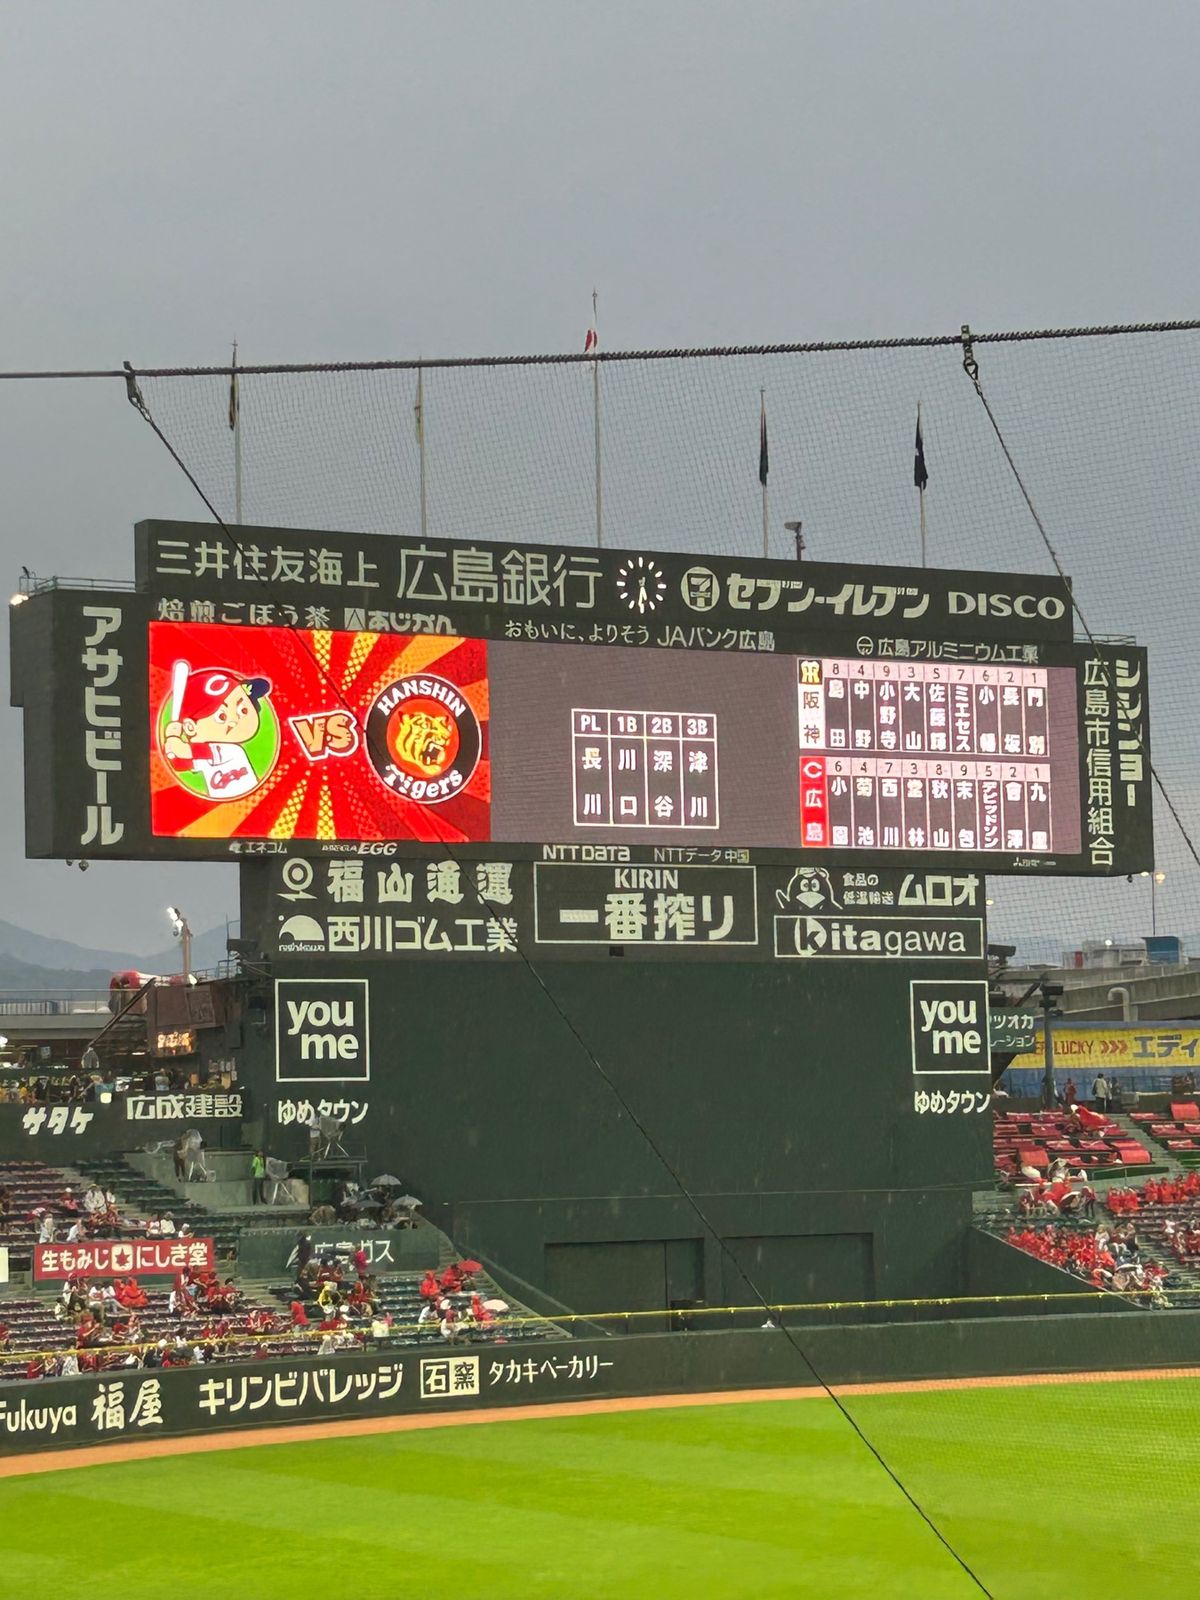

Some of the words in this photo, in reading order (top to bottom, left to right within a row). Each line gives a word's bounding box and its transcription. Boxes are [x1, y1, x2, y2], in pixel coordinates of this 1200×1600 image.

[155, 540, 380, 588] 三井住友海上
[397, 544, 603, 608] 広島銀行
[368, 609, 457, 635] あじかん
[948, 591, 1065, 619] DISCO
[504, 619, 649, 643] おもいに、よりそう
[657, 625, 776, 651] JAバンク広島
[878, 637, 1039, 664] 広島アルミニウム工業
[831, 663, 840, 675] 8
[857, 664, 865, 676] 4
[882, 665, 891, 677] 9
[907, 666, 916, 678] 3
[933, 668, 941, 679] 5
[957, 669, 965, 680] 7
[982, 670, 990, 682] 6
[1007, 671, 1015, 683] 2
[1031, 672, 1037, 684] 1
[377, 679, 466, 717] HANSHIN
[854, 680, 872, 749] 中野
[879, 681, 897, 750] 小野寺
[80, 605, 125, 846] アサヒビール
[580, 714, 601, 732] PL
[617, 715, 638, 733] 1B
[651, 717, 673, 734] 2B
[687, 718, 708, 735] 3B
[803, 691, 820, 744] 阪神
[904, 682, 922, 750] 大山
[954, 685, 971, 752] ミエセス
[291, 712, 356, 759] VS
[834, 760, 842, 773] 6
[860, 761, 868, 774] 4
[884, 762, 893, 774] 7
[910, 763, 918, 775] 3
[935, 763, 943, 776] 8
[960, 764, 968, 776] 9
[985, 765, 993, 777] 5
[1009, 766, 1017, 778] 2
[1034, 767, 1040, 779] 1
[1083, 657, 1115, 866] 広島市信用組合
[383, 763, 463, 799] Tigers
[582, 747, 602, 816] 長川
[618, 749, 638, 816] 川口
[653, 750, 674, 818] 深谷
[688, 750, 709, 818] 津川
[805, 788, 823, 841] 広島
[881, 778, 899, 847] 西川
[931, 779, 950, 847] 秋山
[244, 842, 287, 854] エネコム
[358, 842, 398, 856] EGG
[327, 860, 514, 904] 福山通運
[614, 868, 679, 889] KIRIN
[842, 872, 879, 887] 食品の
[898, 873, 980, 907] ムロオ
[327, 915, 518, 952] 西川ゴム工業
[286, 1000, 355, 1036] you
[920, 1000, 978, 1032] you
[990, 1014, 1035, 1030] ツオカ
[301, 1033, 360, 1060] me
[932, 1030, 982, 1055] me
[1054, 1039, 1095, 1056] LUCKY
[1132, 1033, 1199, 1058] エディ
[126, 1094, 243, 1120] 広成建設
[277, 1098, 369, 1125] ゆめタウン
[914, 1090, 991, 1114] ゆめタウン
[22, 1106, 94, 1136] サタケ
[41, 1248, 109, 1272] 生もみじ
[136, 1242, 208, 1269] にしき堂
[199, 1362, 403, 1416] キリンビバレッジ
[424, 1360, 477, 1394] 石窯
[91, 1378, 164, 1430] 福屋
